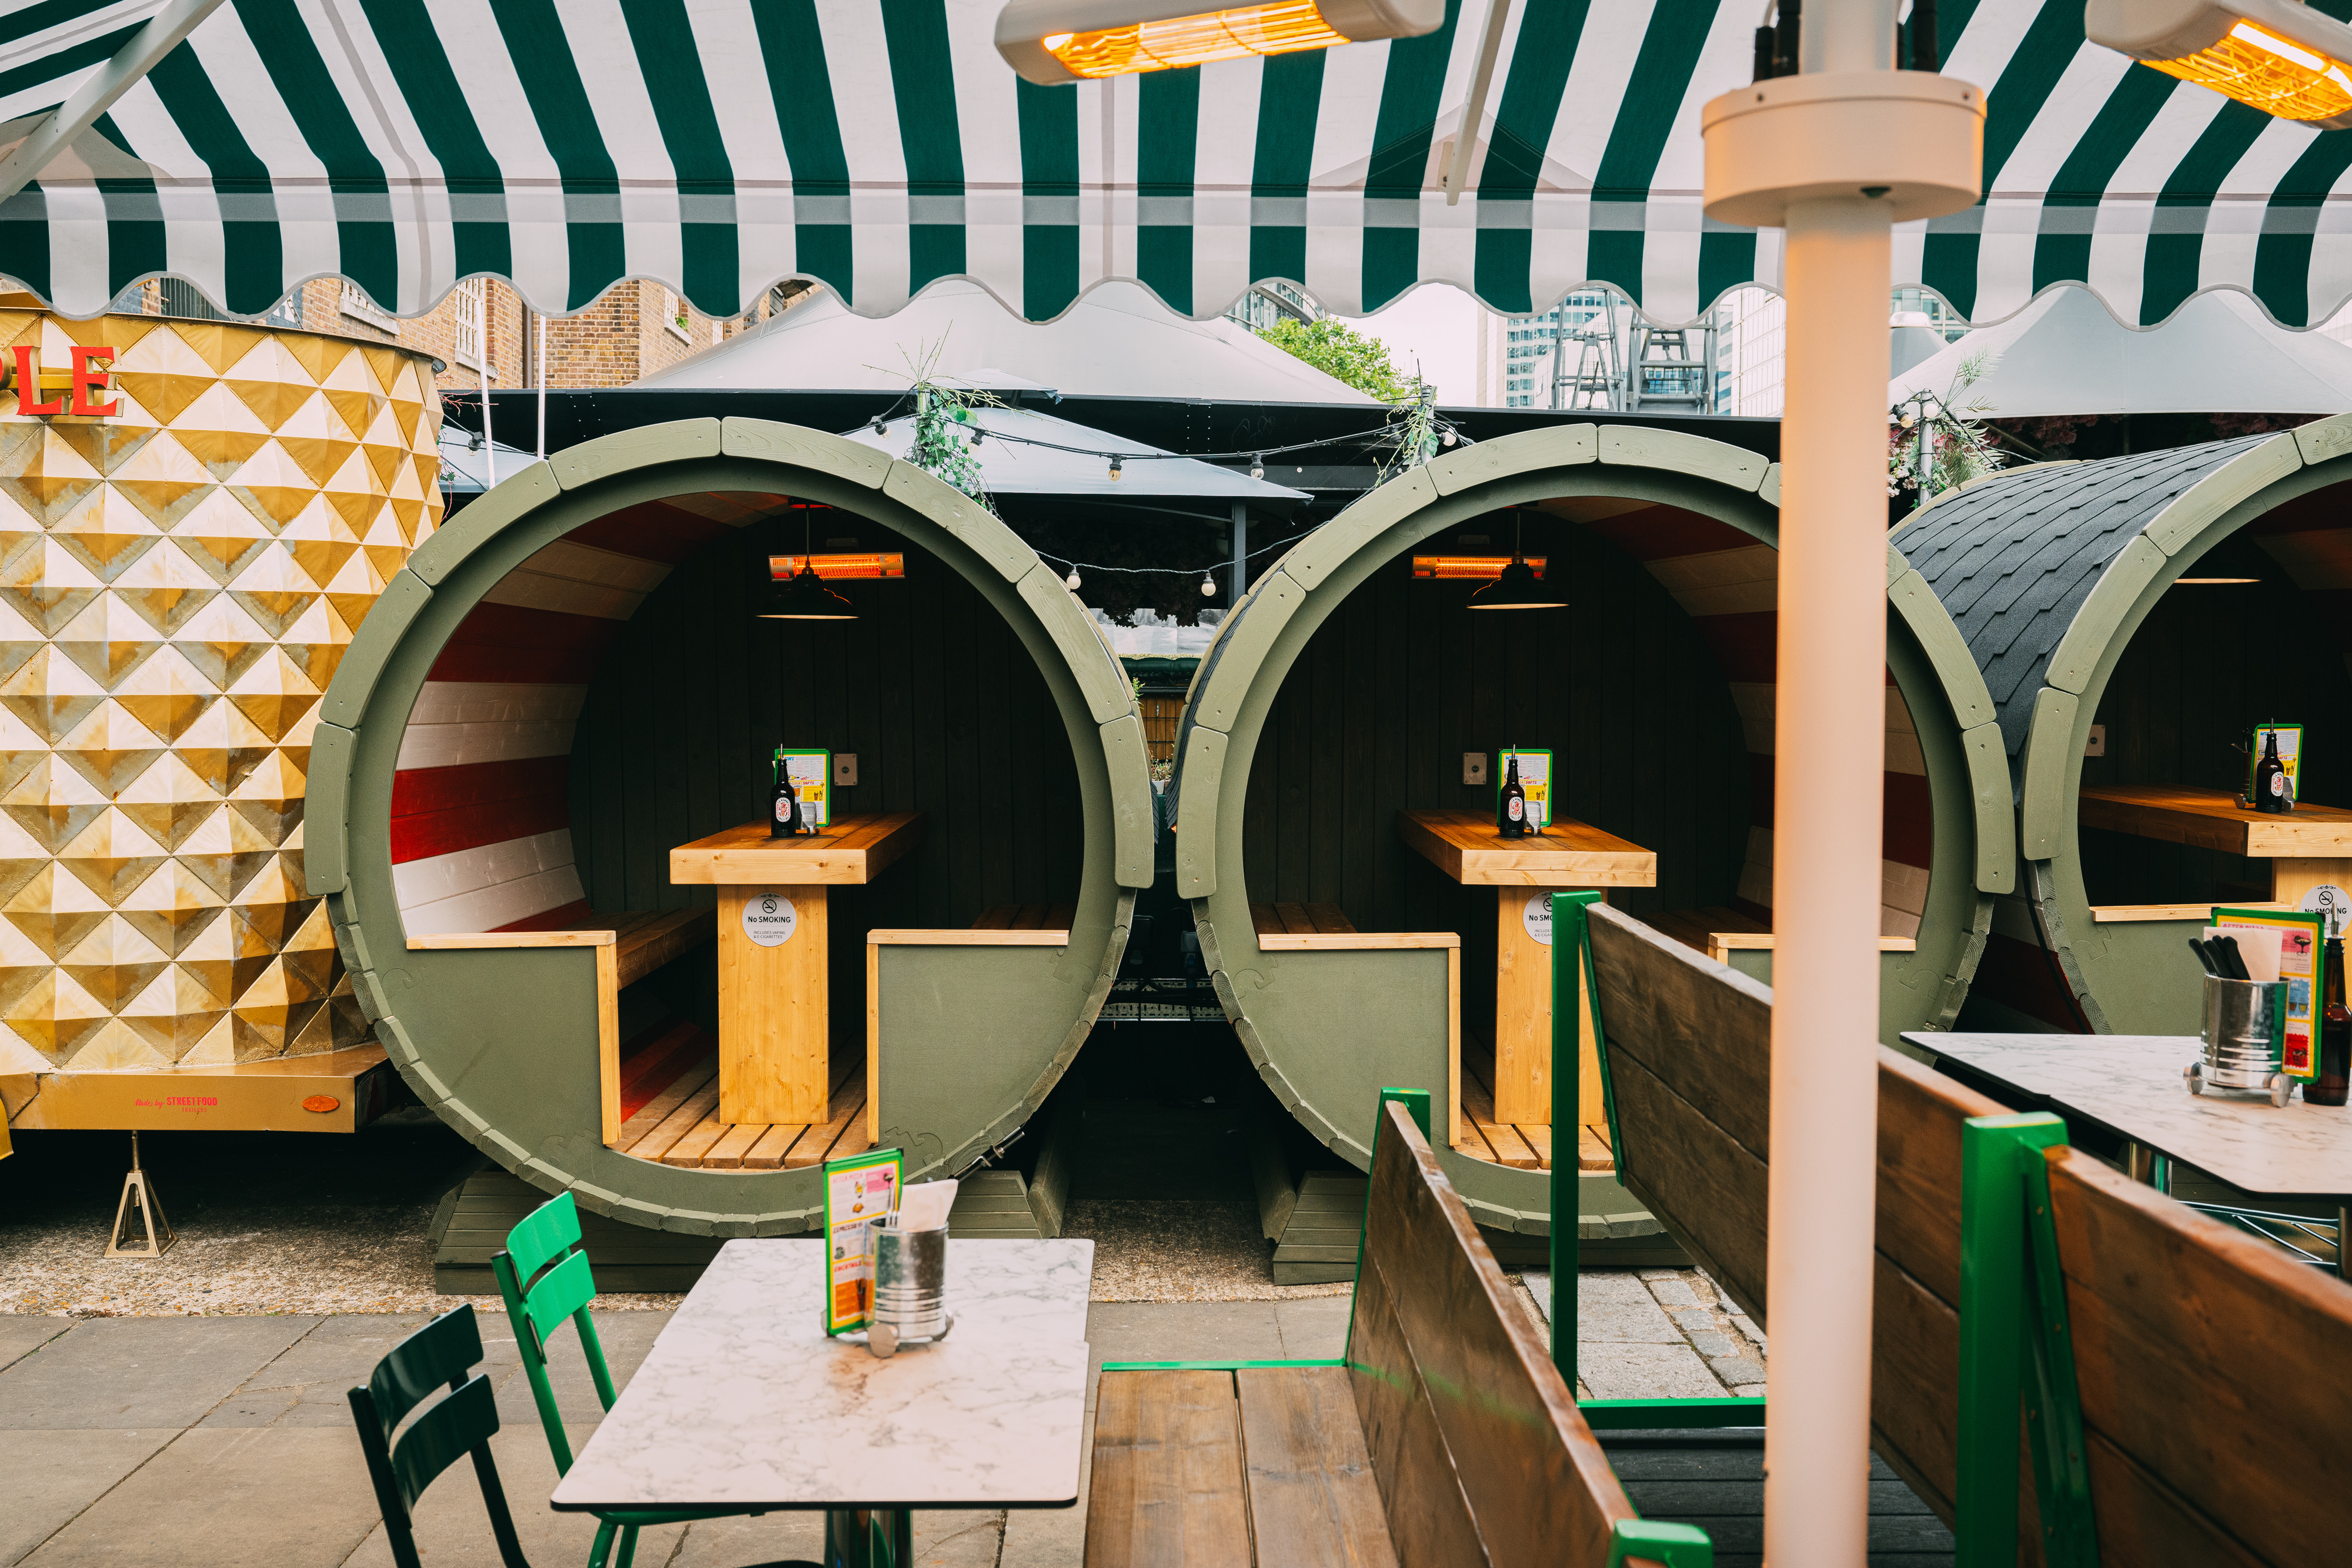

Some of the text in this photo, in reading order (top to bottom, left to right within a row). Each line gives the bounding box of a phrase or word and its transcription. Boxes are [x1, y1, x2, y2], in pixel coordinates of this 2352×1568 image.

[0, 345, 125, 417] LE
[134, 1096, 218, 1109] Made by STREET FOOD
